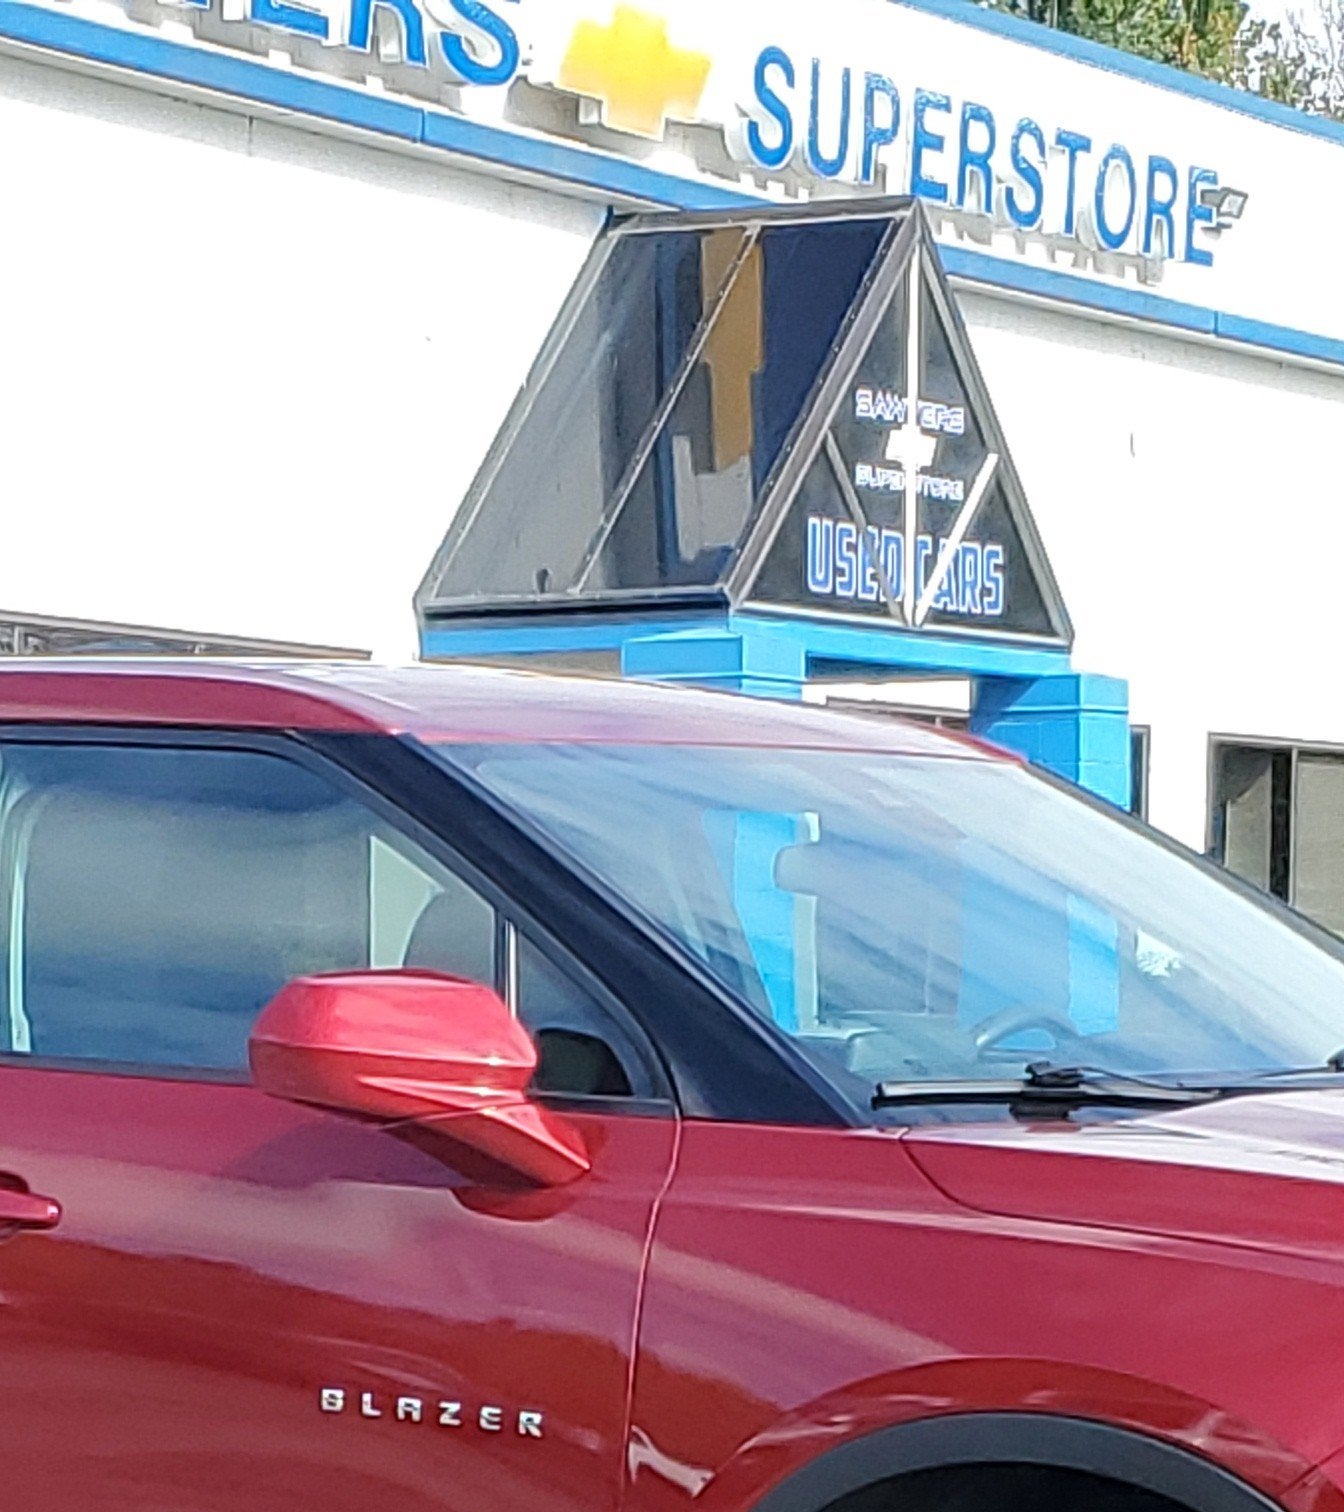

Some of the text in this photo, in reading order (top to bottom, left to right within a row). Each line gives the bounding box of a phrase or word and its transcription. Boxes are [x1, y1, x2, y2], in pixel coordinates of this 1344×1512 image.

[747, 46, 1219, 267] SUPERSTORE
[856, 388, 964, 435] SAWERS
[807, 516, 1005, 616] USED CARS
[320, 1388, 543, 1438] BLAZER
